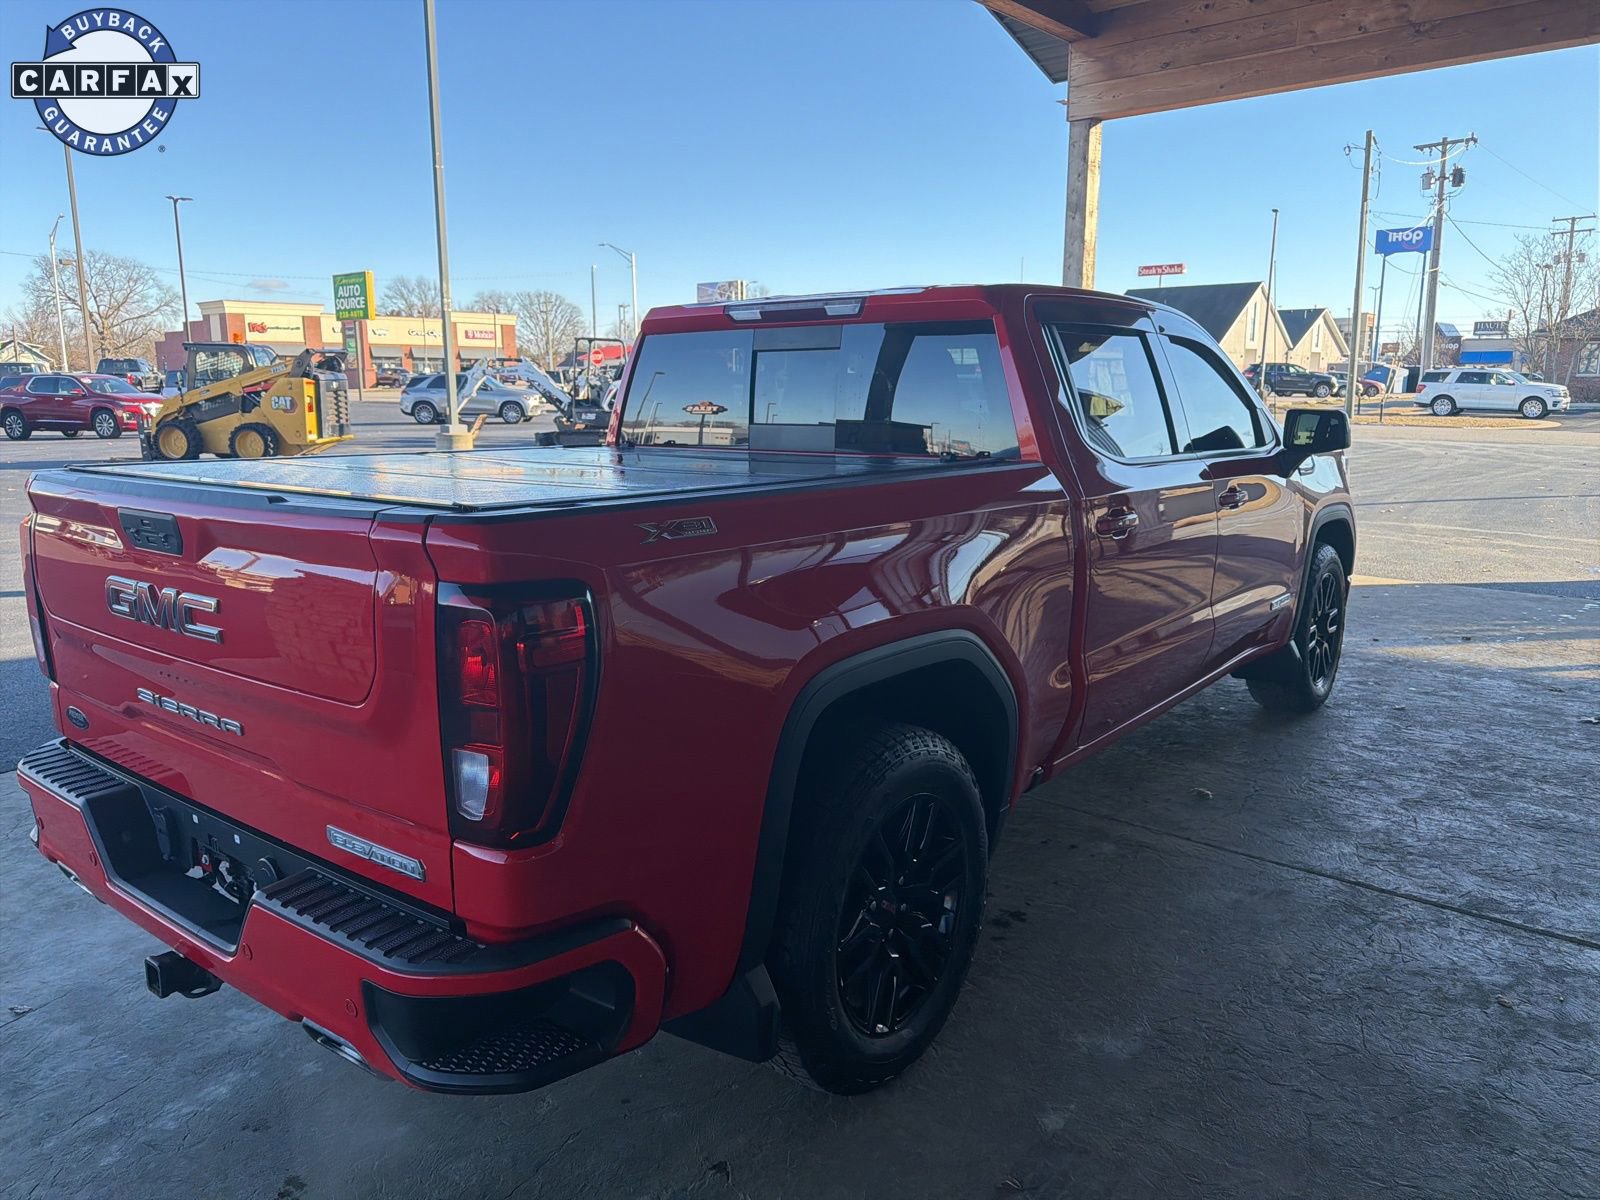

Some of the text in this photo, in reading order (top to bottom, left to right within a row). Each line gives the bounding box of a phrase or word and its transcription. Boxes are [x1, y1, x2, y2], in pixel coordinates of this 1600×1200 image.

[336, 297, 366, 310] SOURCE
[337, 284, 361, 297] AUTO
[271, 396, 292, 410] CAT
[105, 575, 224, 645] GMC
[137, 687, 244, 736] SIERRA
[330, 830, 418, 875] ELEVATION
